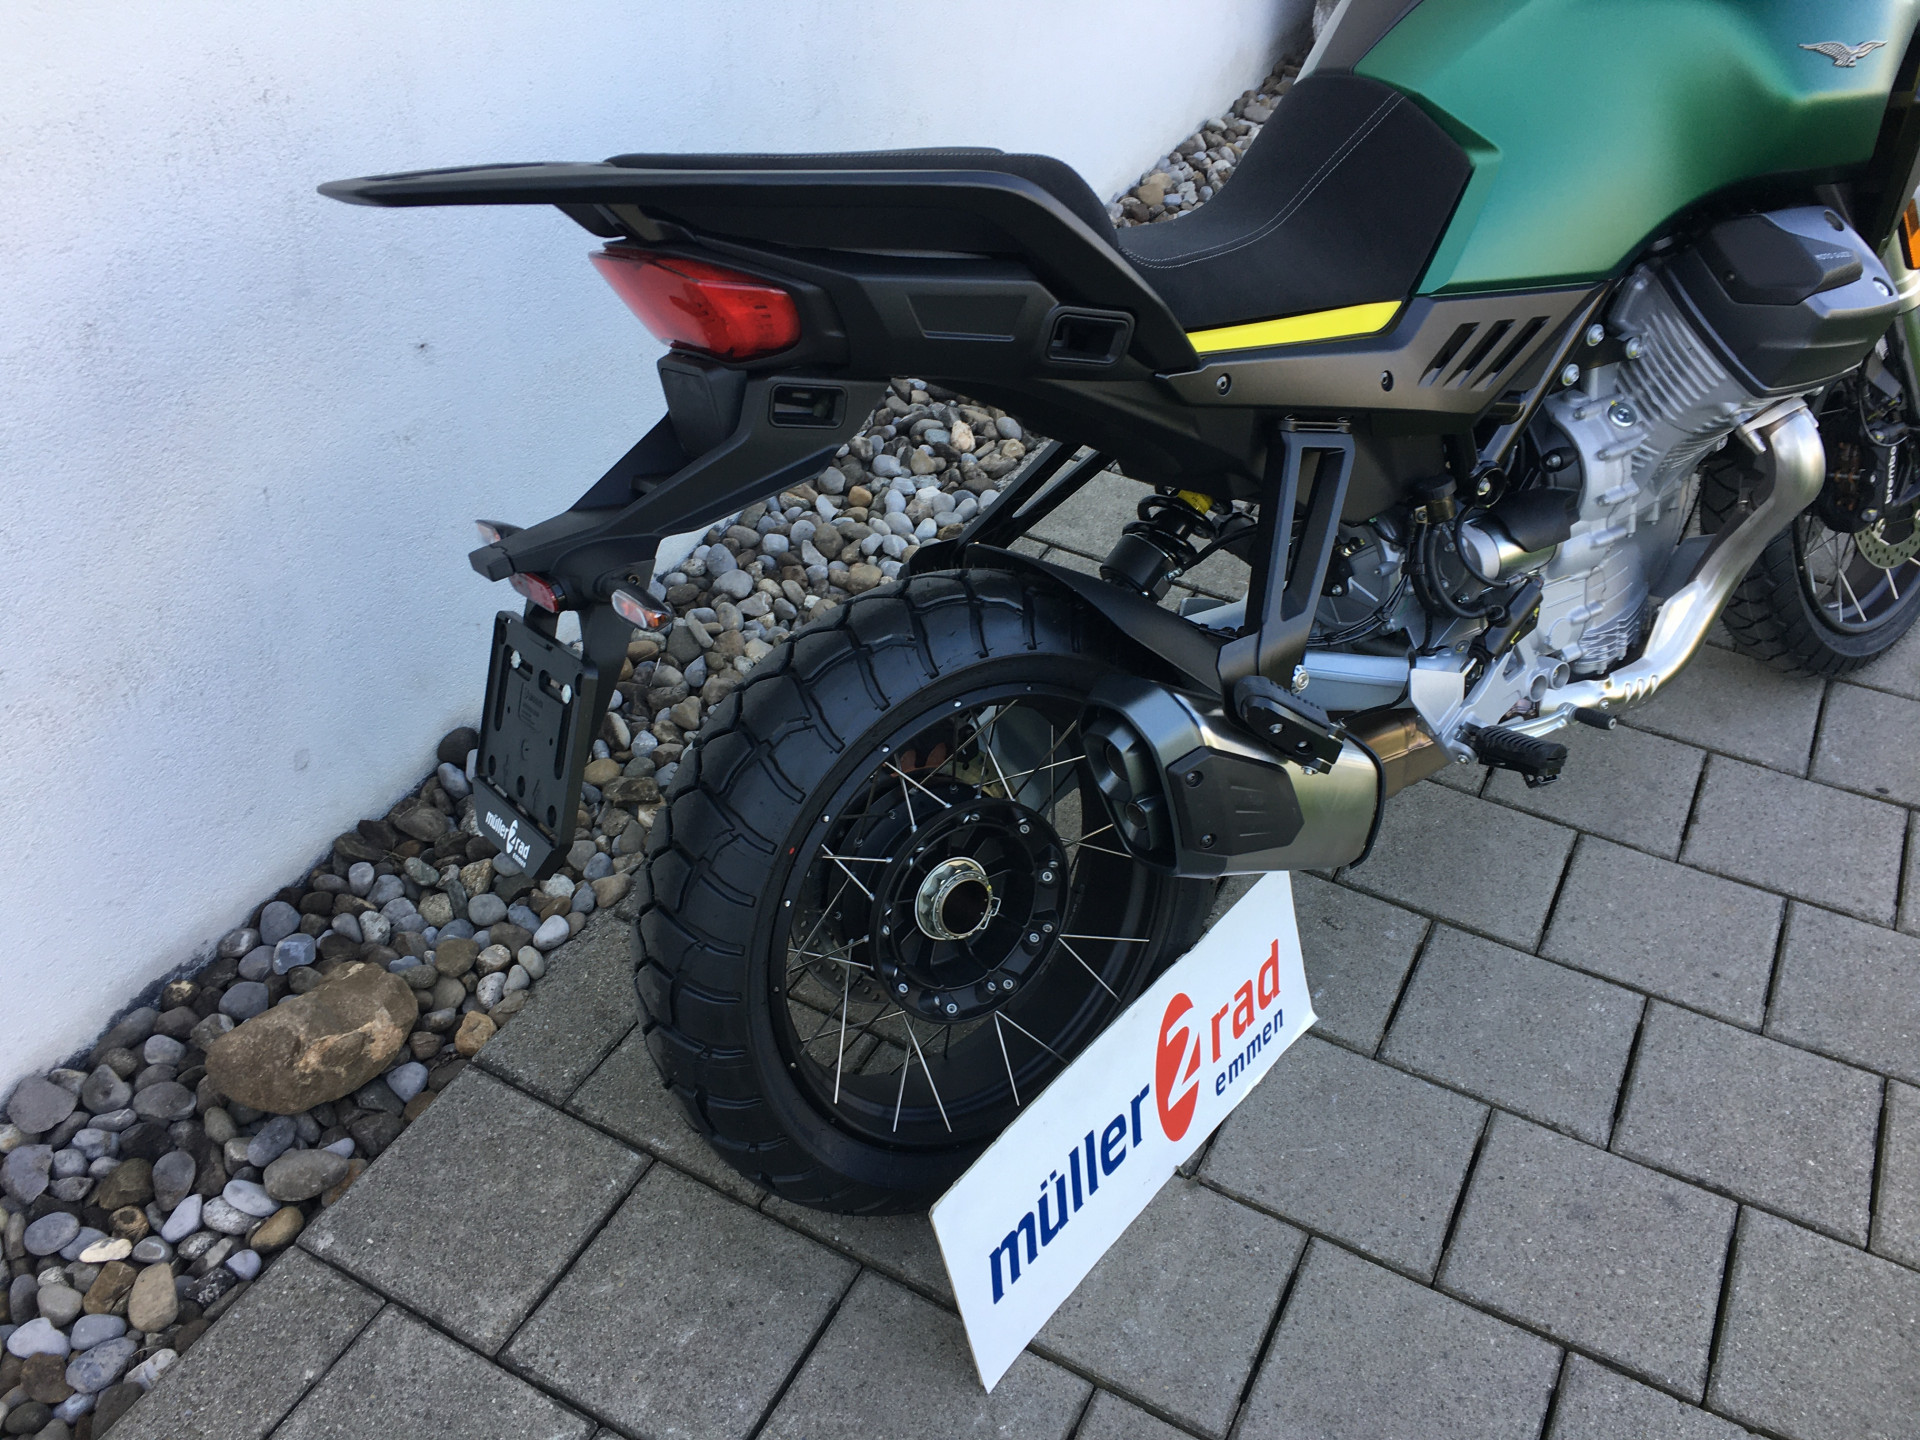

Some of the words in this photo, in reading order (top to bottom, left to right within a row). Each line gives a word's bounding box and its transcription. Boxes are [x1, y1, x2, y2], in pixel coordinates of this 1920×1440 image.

[1884, 445, 1898, 505] brembo
[1215, 1009, 1283, 1097] emmen
[988, 1083, 1150, 1305] müller
